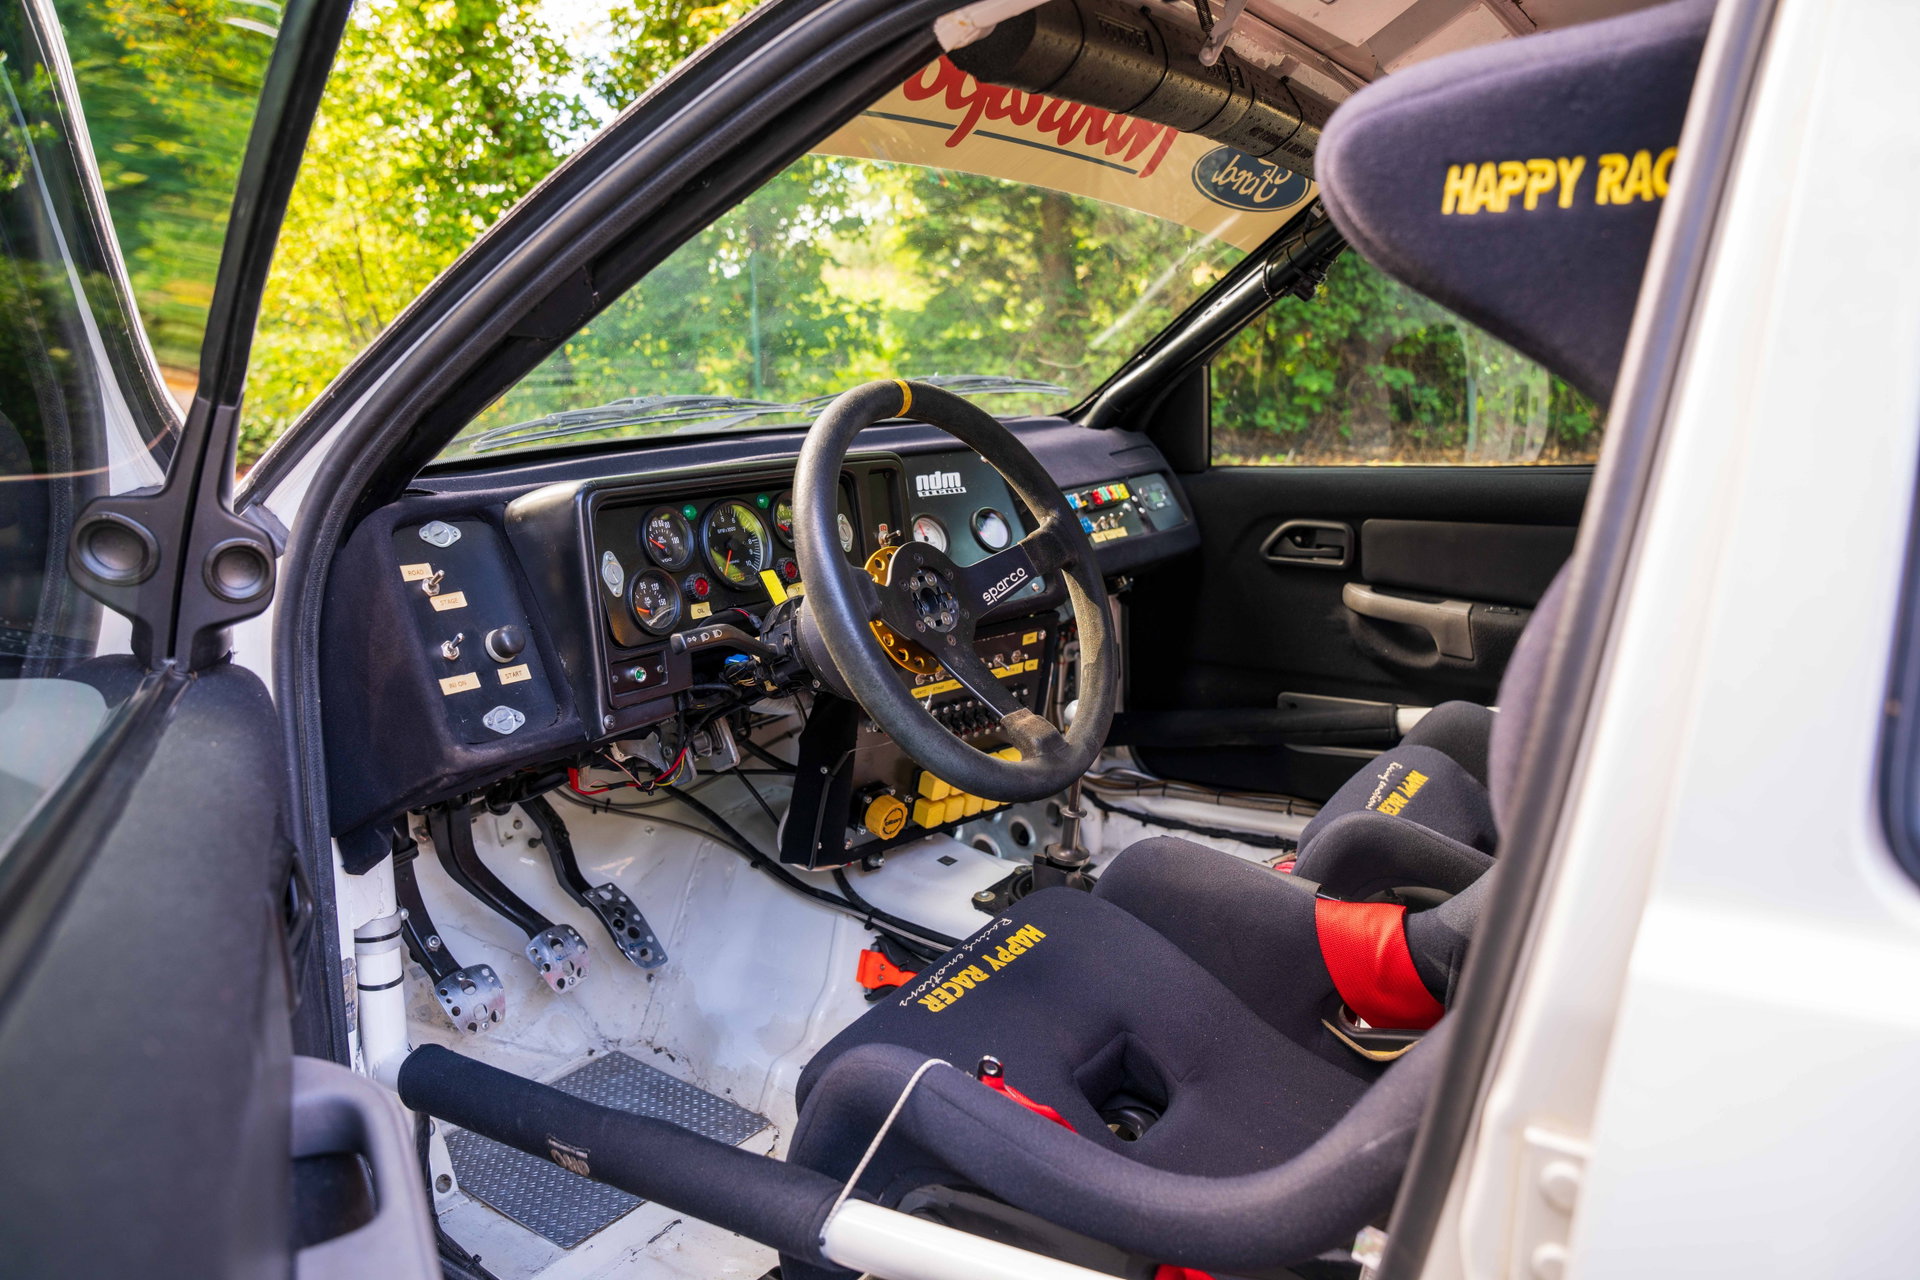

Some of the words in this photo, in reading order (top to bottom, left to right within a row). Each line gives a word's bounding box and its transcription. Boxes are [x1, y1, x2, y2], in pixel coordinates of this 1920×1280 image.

[1441, 155, 1587, 215] HAPPY
[915, 471, 962, 491] ndm
[440, 597, 459, 605] STAGE
[982, 566, 1026, 603] sparco
[504, 670, 522, 680] START
[1397, 770, 1429, 798] HAPPY
[962, 917, 1013, 952] Racing
[981, 923, 1047, 972] HAPPY
[899, 953, 964, 1007] emotions
[917, 964, 990, 1013] RACER
